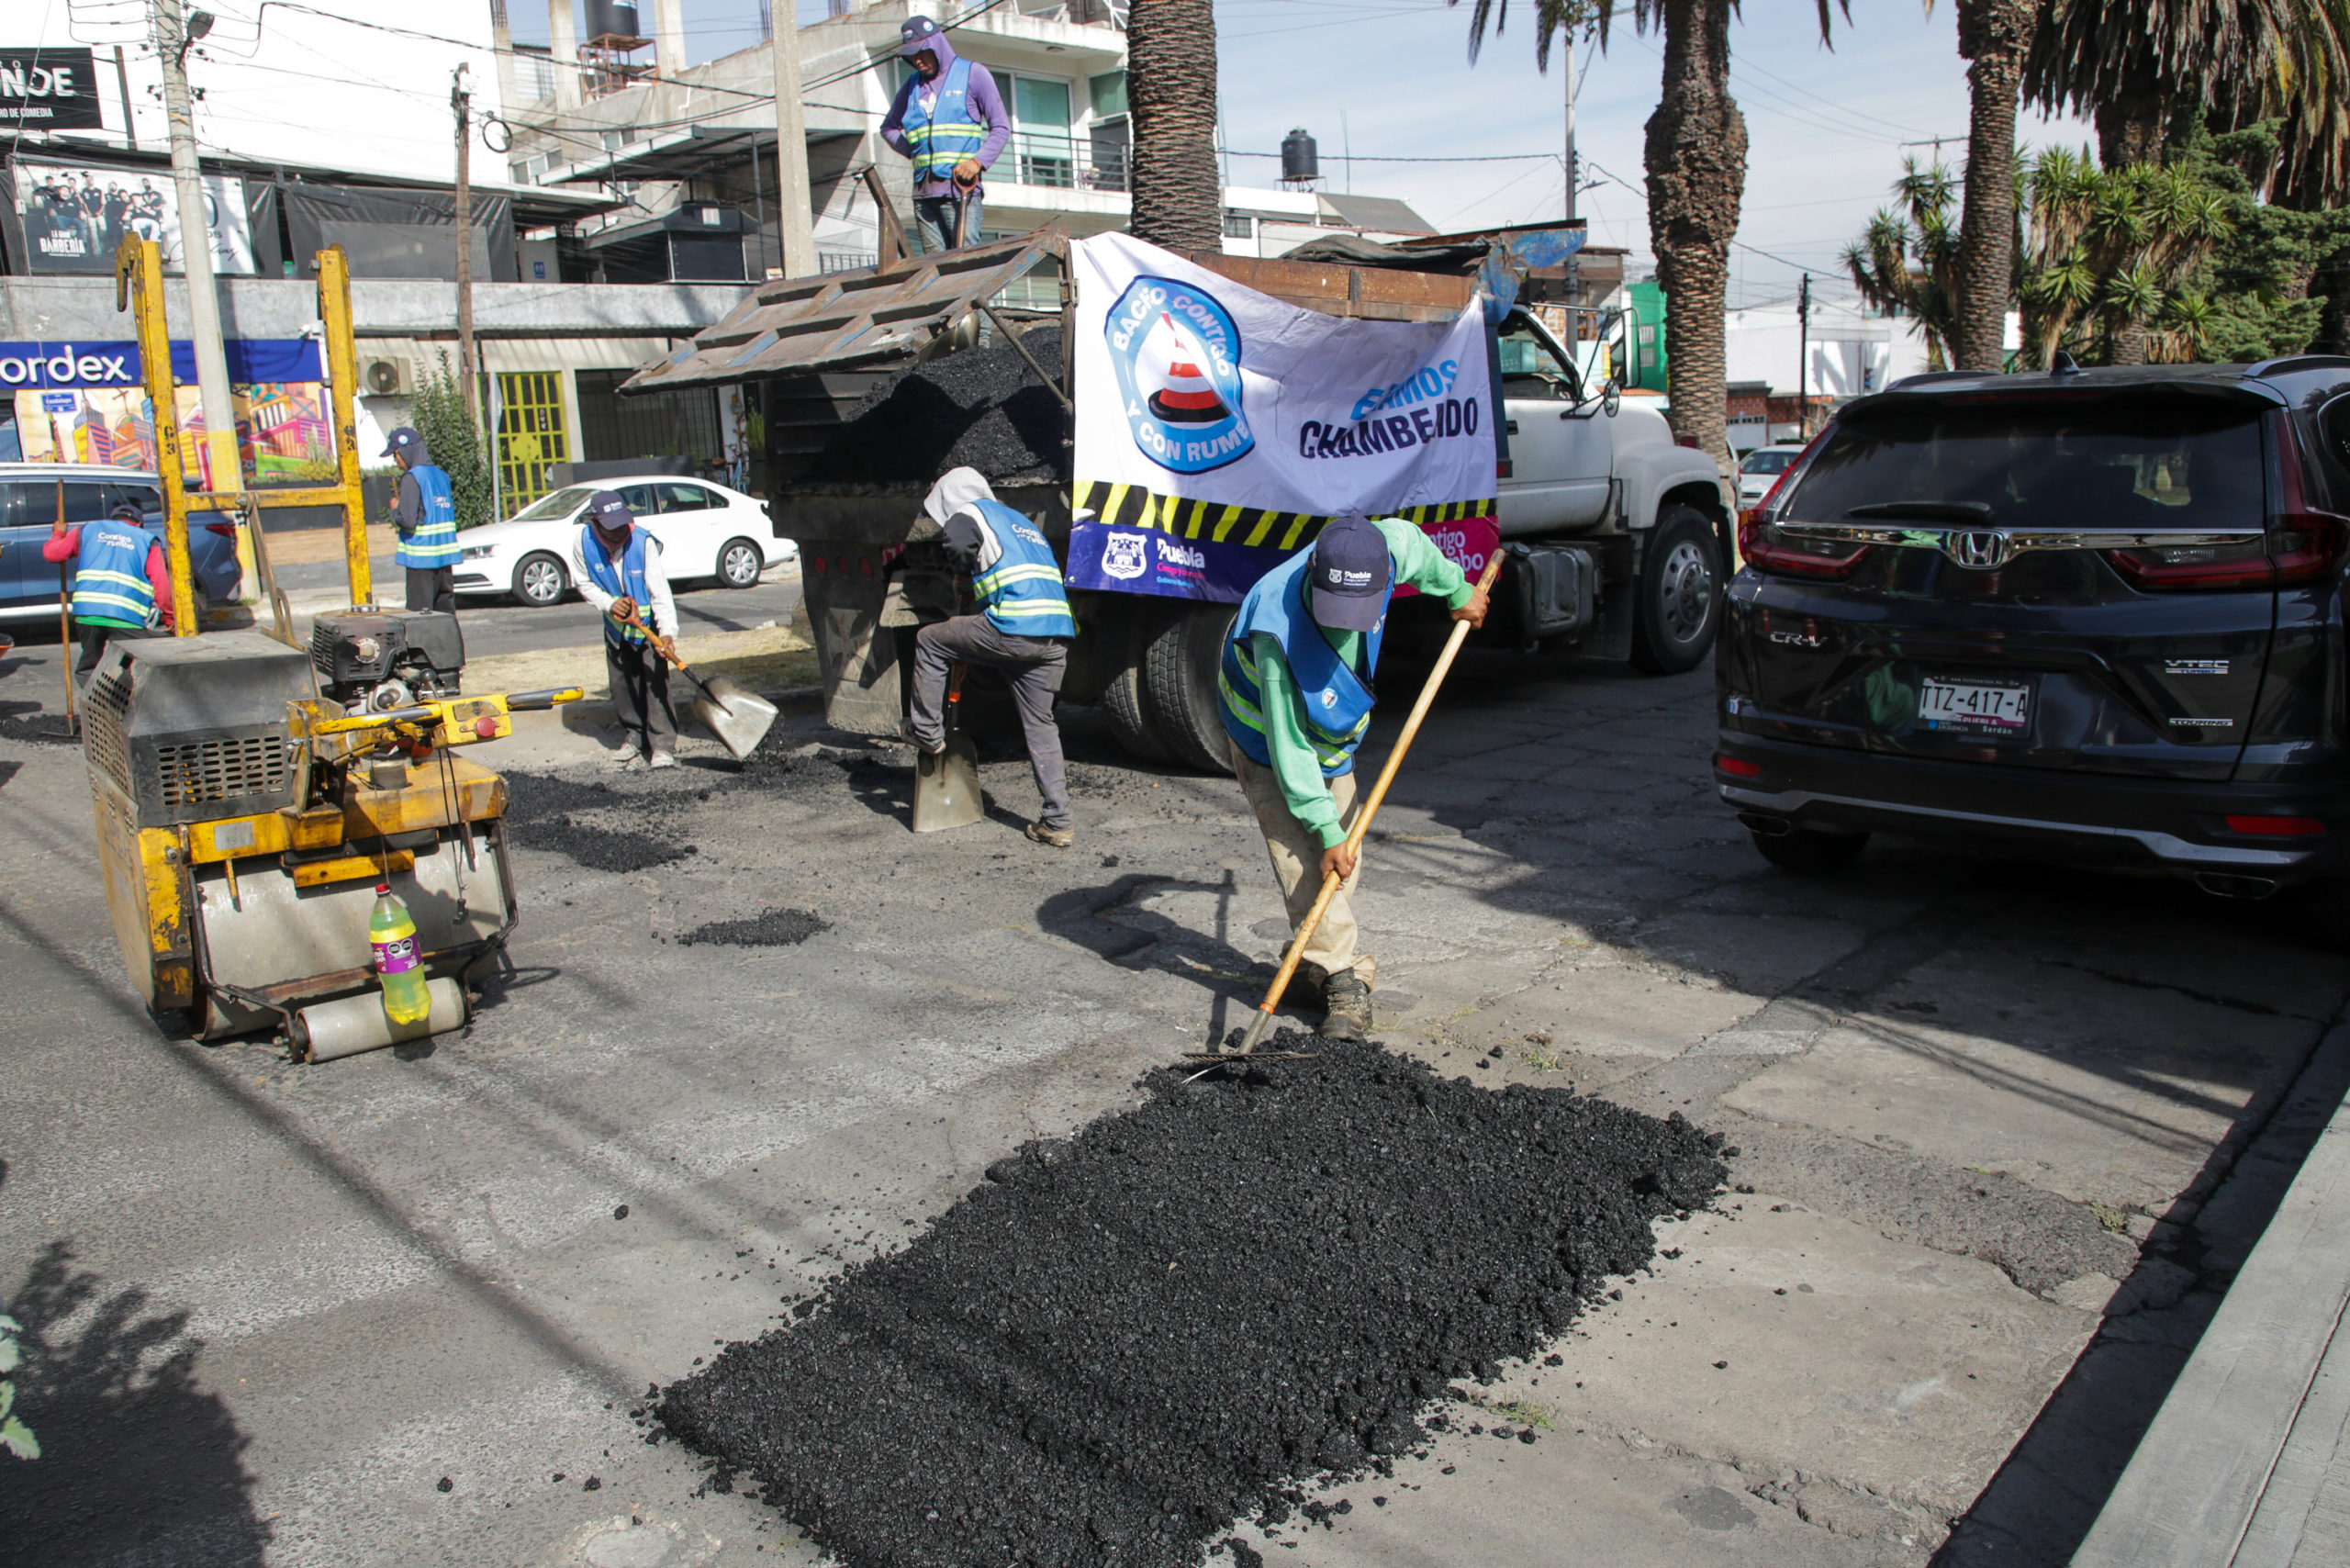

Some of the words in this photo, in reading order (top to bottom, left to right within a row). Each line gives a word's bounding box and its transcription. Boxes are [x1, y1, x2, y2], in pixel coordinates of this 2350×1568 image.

[8, 106, 20, 118] DE
[19, 106, 54, 118] COMEDIA
[1172, 294, 1231, 377] CONTIGO
[1126, 398, 1143, 419] Y
[1139, 421, 1181, 461] CON
[1186, 410, 1249, 462] RUMB
[1157, 537, 1206, 569] Puebla
[1428, 526, 1466, 556] ntigo
[1344, 570, 1372, 579] Puebla
[1769, 631, 1830, 648] CR-V
[2165, 659, 2231, 668] VTEC
[1922, 685, 2027, 717] TTZ-417-A
